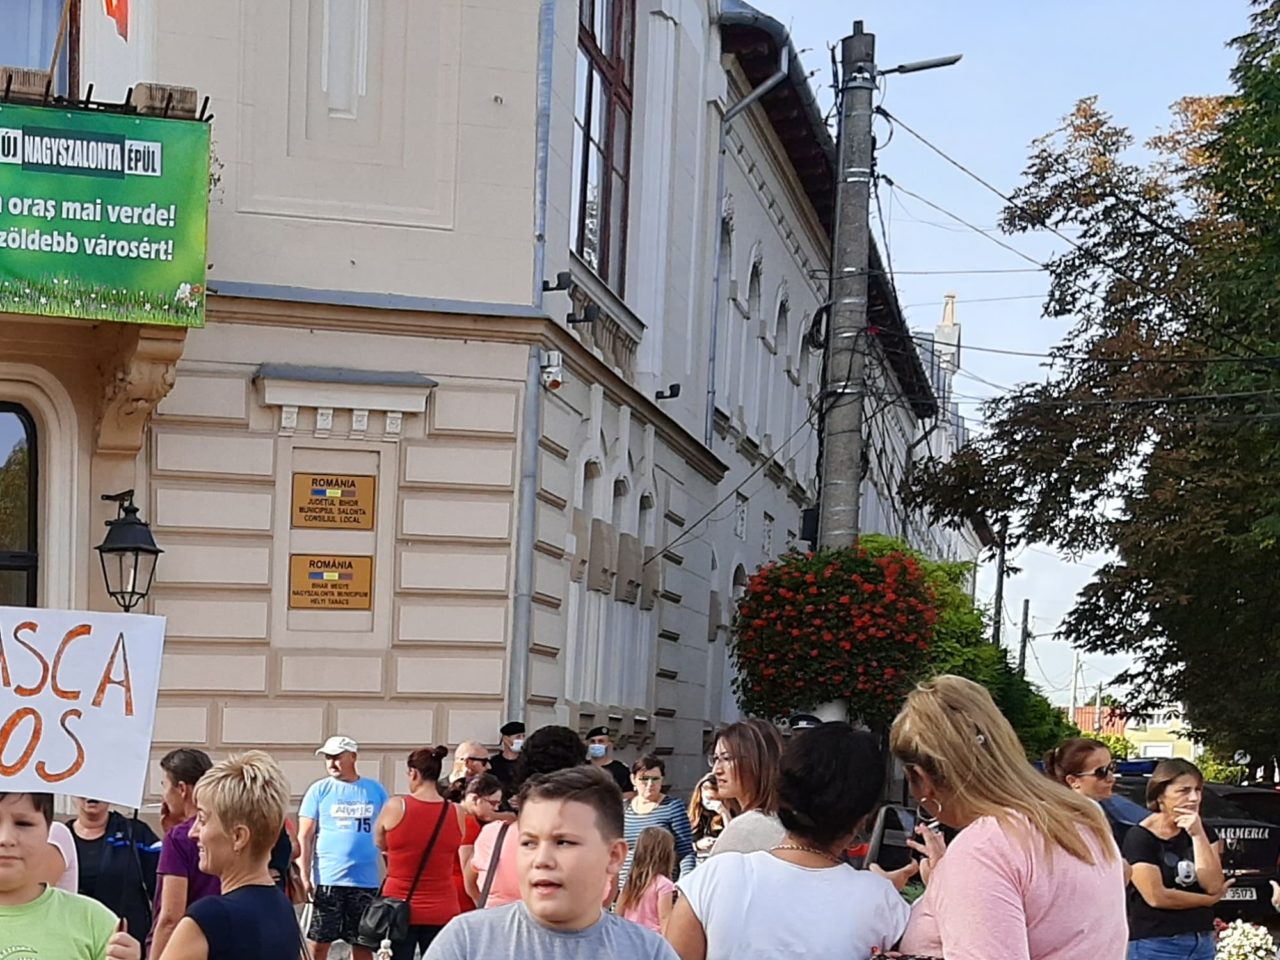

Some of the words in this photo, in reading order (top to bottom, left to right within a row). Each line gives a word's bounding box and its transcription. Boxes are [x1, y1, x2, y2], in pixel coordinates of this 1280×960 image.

[1, 131, 18, 158] ÚJ
[24, 135, 122, 171] NAGYSZALONTA
[127, 144, 158, 173] ÉPÜL
[61, 199, 102, 222] mai
[107, 204, 176, 228] verde!
[83, 234, 174, 261] városért!
